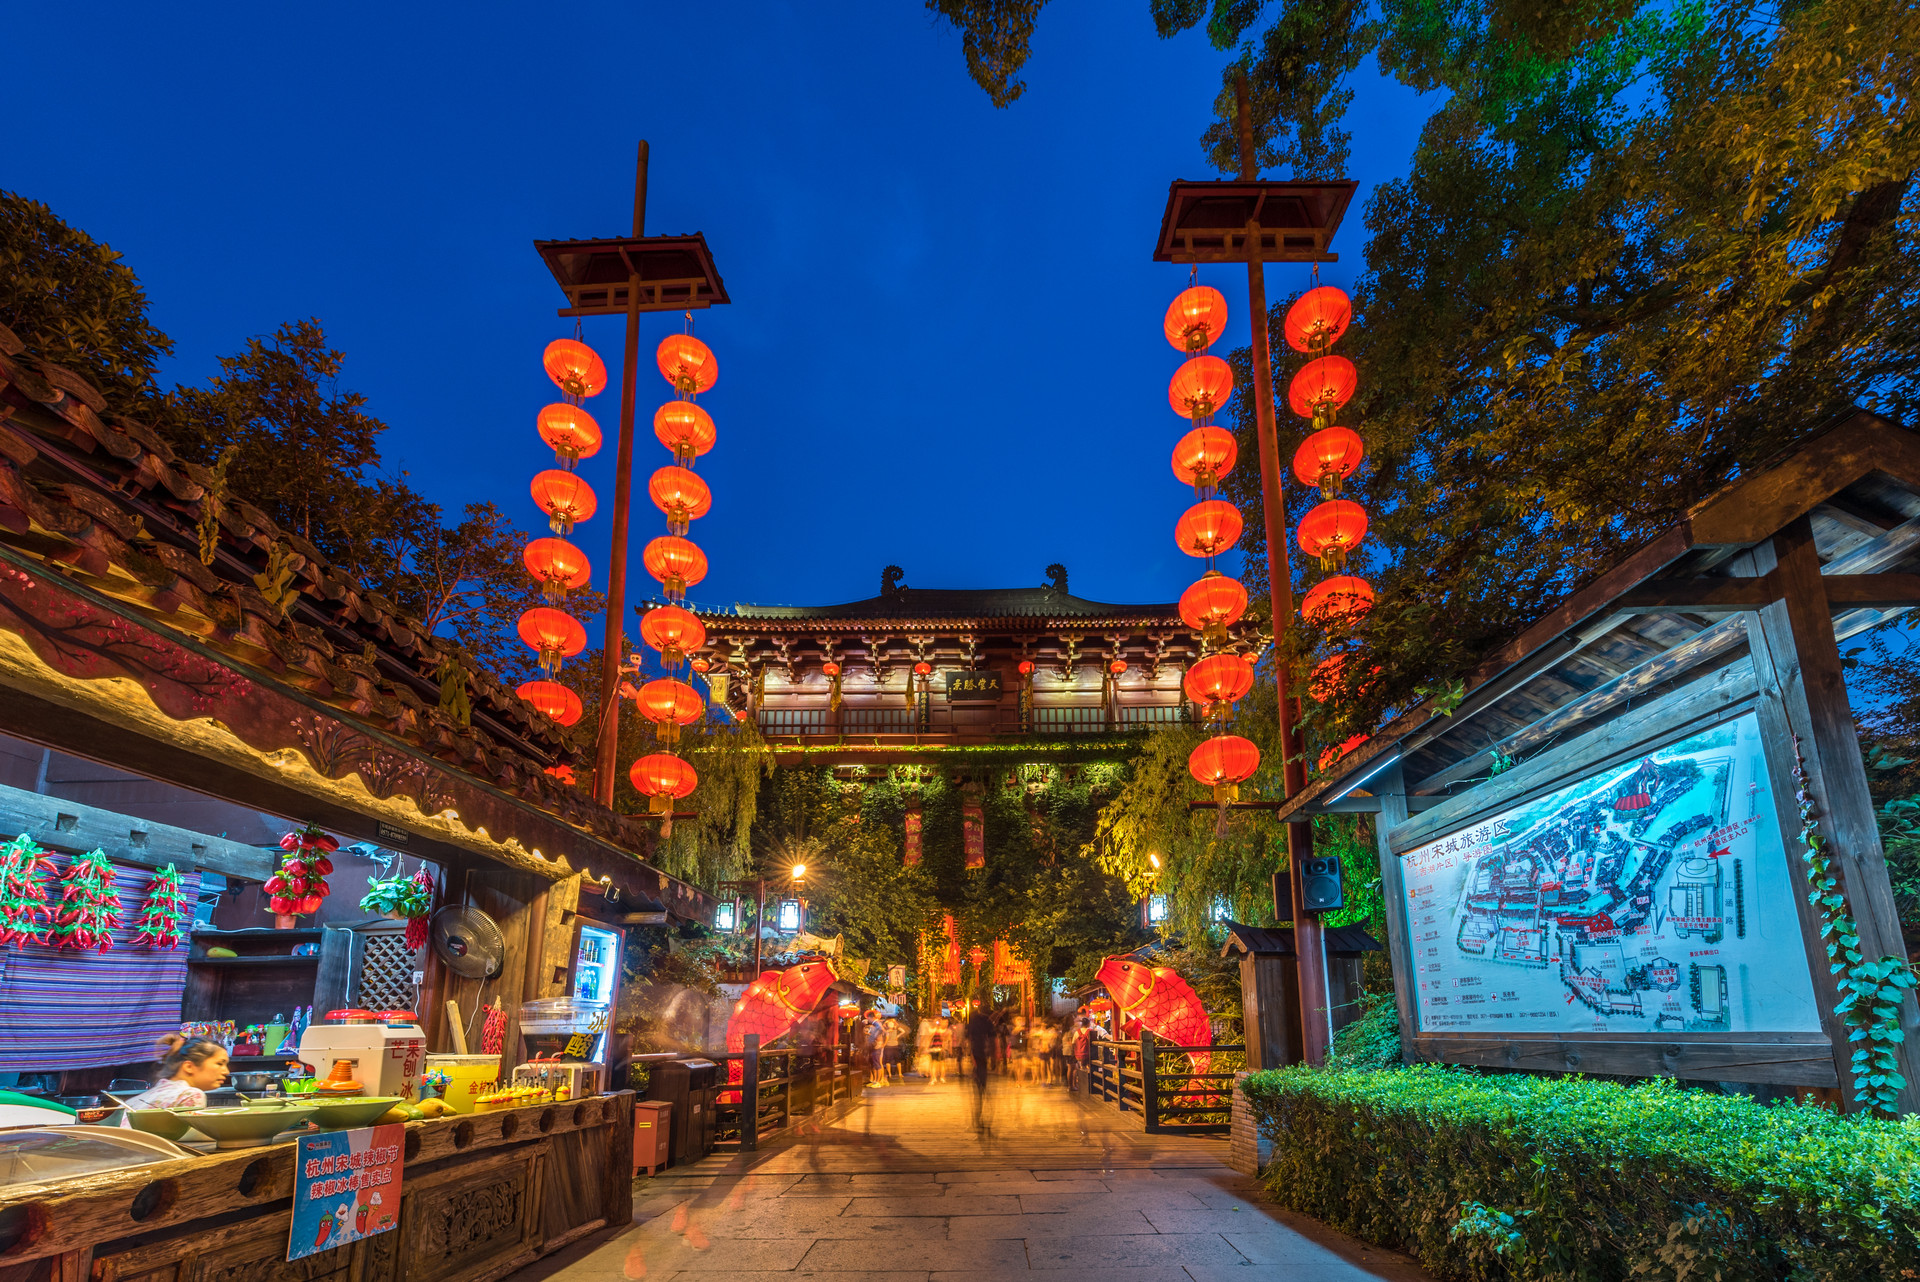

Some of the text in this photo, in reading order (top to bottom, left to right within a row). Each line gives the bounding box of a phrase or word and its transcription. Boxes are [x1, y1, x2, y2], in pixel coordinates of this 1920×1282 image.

[1406, 818, 1511, 868] 杭州宋城旅游区
[1694, 822, 1740, 848] 杭州宋城旅游区
[1714, 827, 1748, 847] 景区主入口
[1462, 843, 1493, 862] 导游图
[1652, 968, 1677, 976] 宋城演艺
[1657, 976, 1675, 984] 办公楼
[391, 1040, 420, 1059] 芒果
[400, 1058, 417, 1100] 刨冰
[305, 1144, 399, 1178] 杭州宋城辣椒节
[310, 1167, 392, 1200] 辣椒冰棒售卖点
